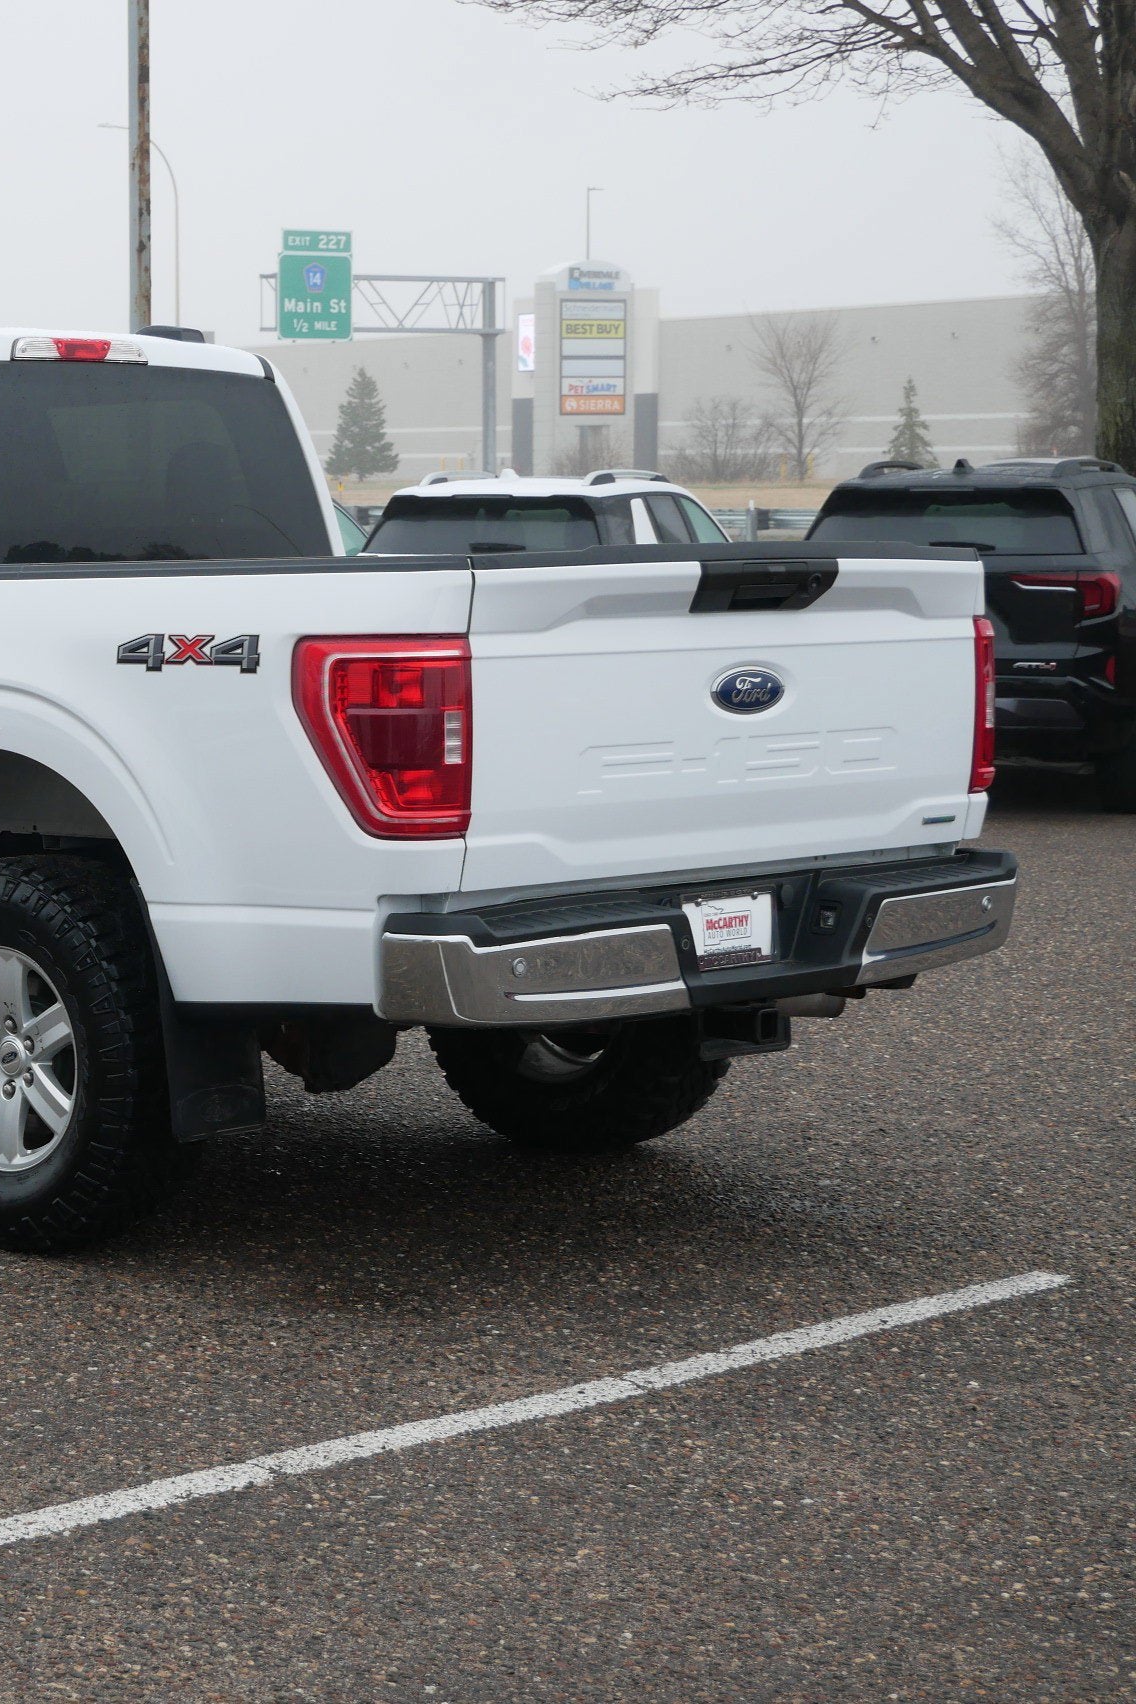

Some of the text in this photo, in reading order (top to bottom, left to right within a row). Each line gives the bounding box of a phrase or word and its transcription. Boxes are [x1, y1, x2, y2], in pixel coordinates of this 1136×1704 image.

[287, 235, 346, 249] EXIT 227
[309, 272, 321, 286] 14
[284, 298, 347, 313] Main St
[314, 321, 337, 330] MILE
[566, 323, 621, 335] BEST BUY
[579, 400, 620, 410] SIERRA
[731, 676, 772, 703] Ford
[577, 726, 898, 795] F-150
[705, 914, 749, 931] McCARTHY
[707, 927, 748, 939] AUTO WORLD
